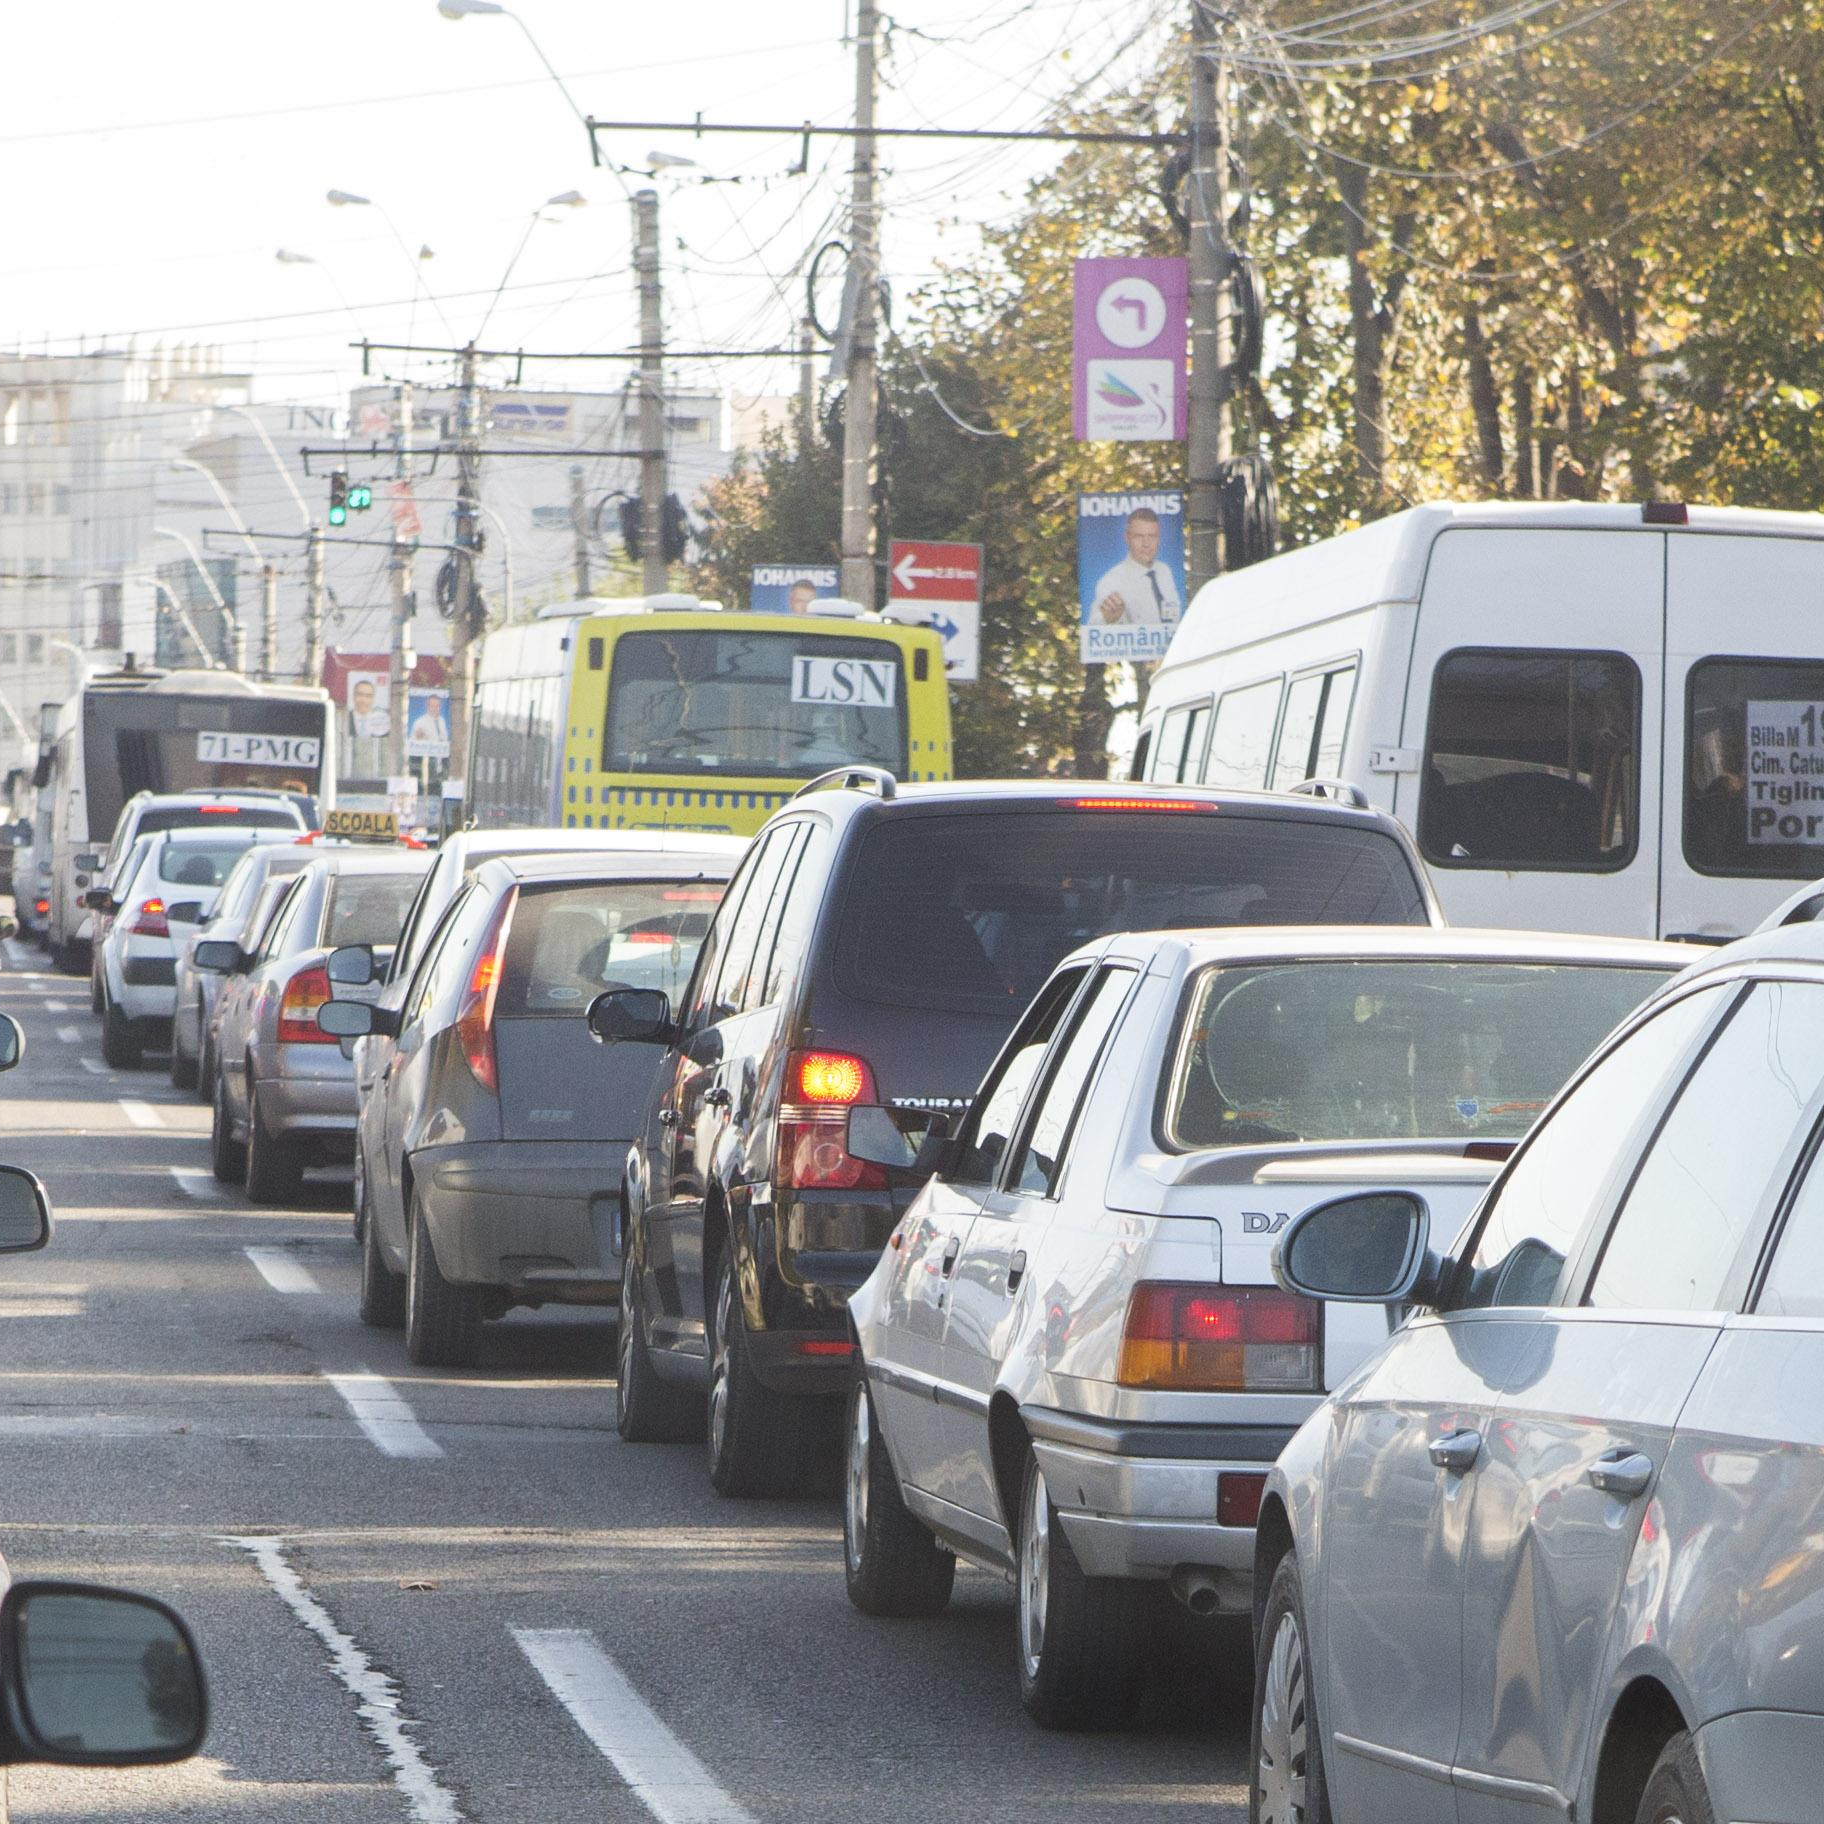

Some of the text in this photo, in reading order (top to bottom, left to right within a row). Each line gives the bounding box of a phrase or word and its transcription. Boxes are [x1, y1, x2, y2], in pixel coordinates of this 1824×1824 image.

[1080, 493, 1181, 518] IOHANNIS
[753, 569, 838, 587] IOHANNIS
[1089, 627, 1175, 647] Români
[800, 660, 891, 702] LSN
[203, 735, 317, 765] 71-PMG
[1751, 751, 1785, 774] Cim.
